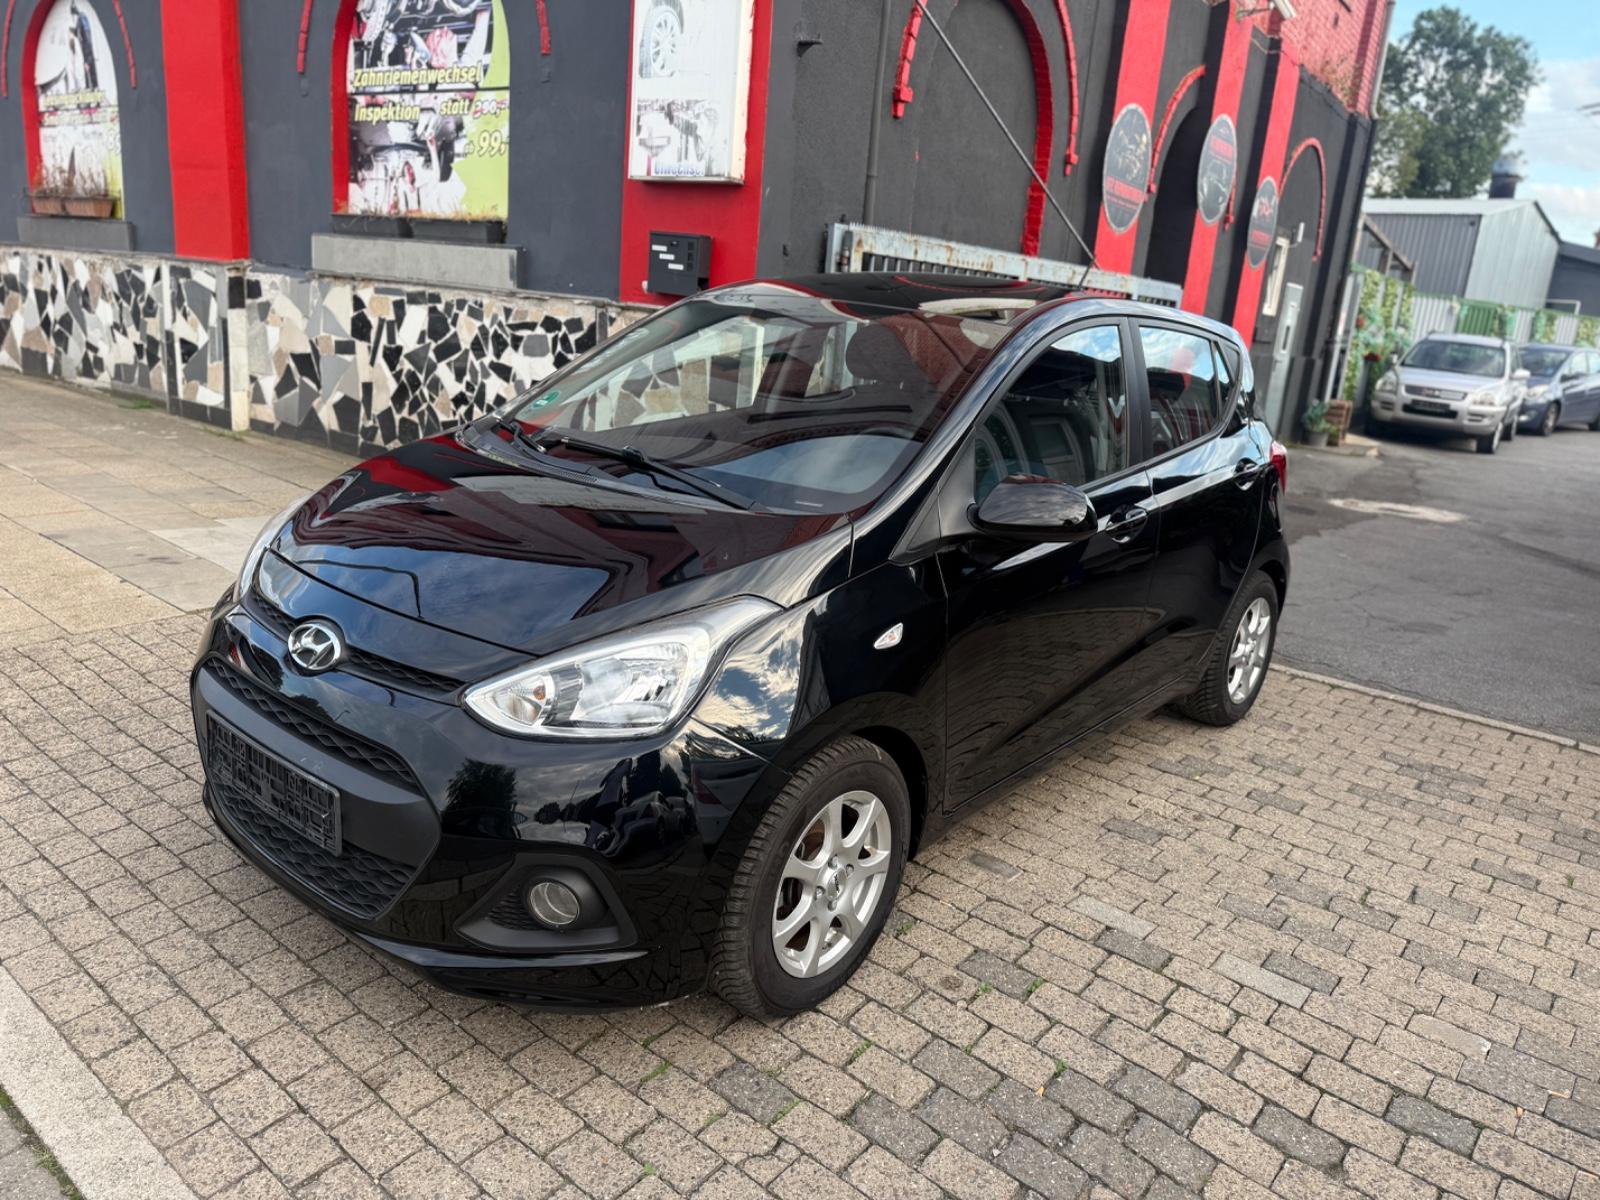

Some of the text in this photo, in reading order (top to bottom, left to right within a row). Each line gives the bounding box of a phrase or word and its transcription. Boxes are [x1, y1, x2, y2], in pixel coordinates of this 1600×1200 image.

[353, 61, 483, 87] Zahnriemenwechsel
[354, 102, 421, 126] Inspektion
[440, 99, 470, 116] statt
